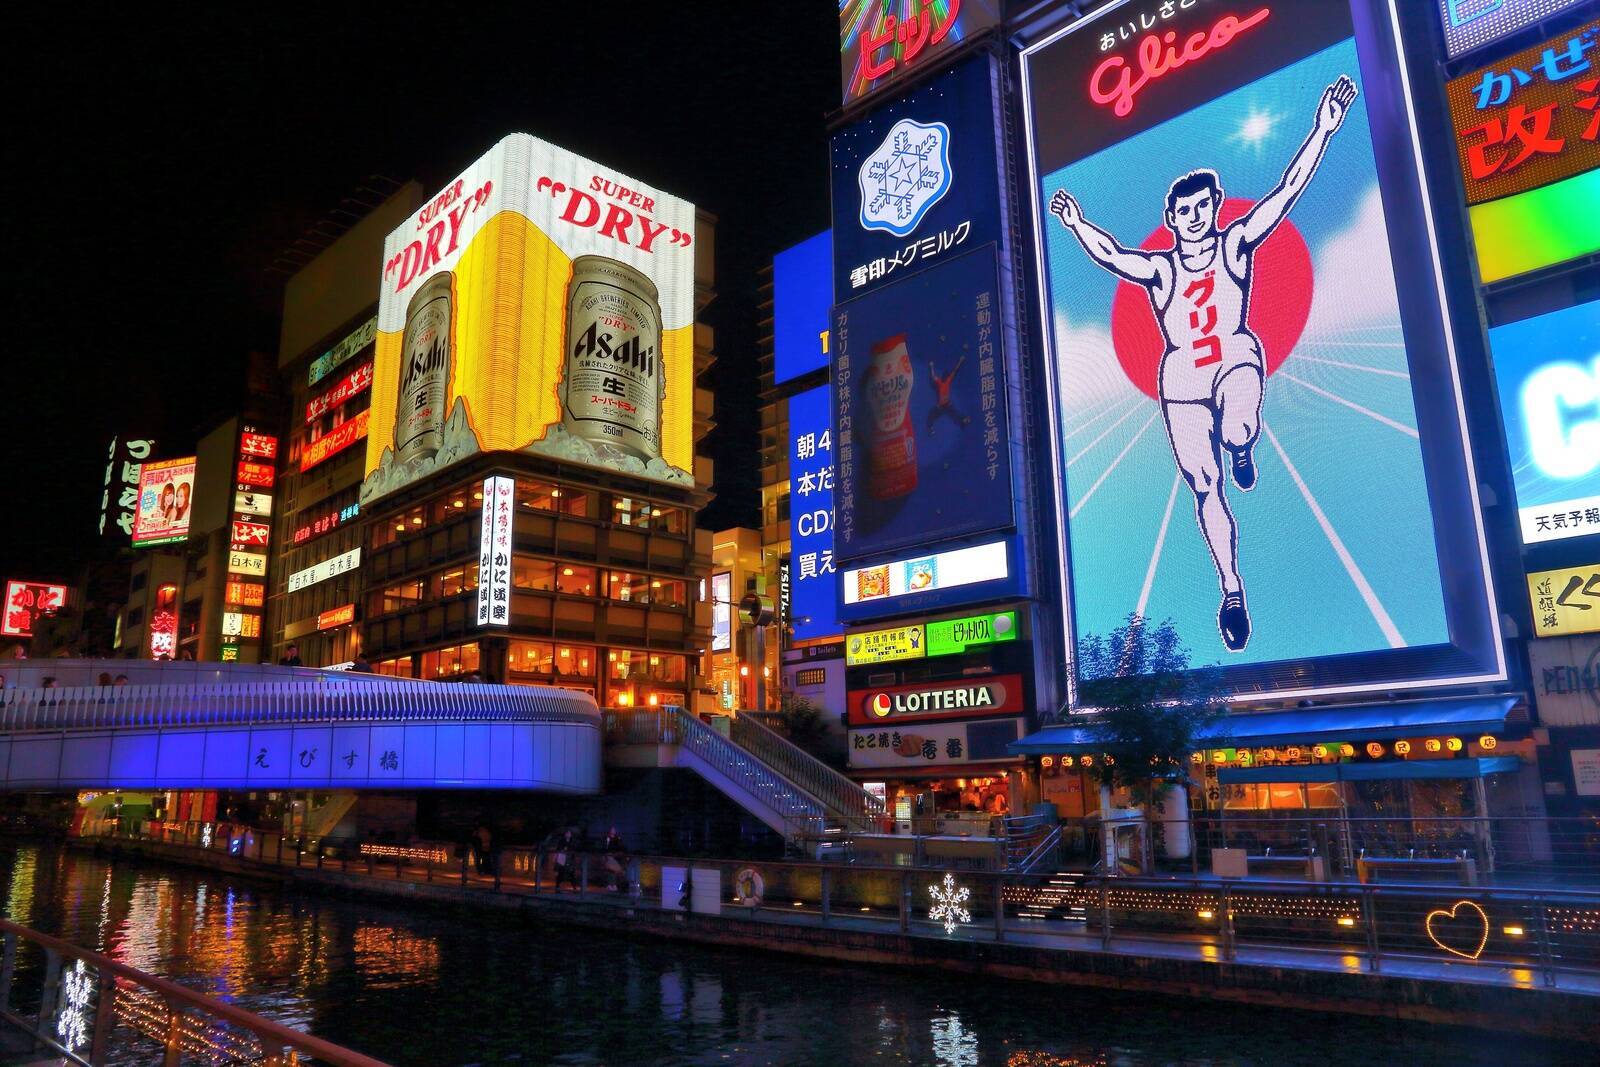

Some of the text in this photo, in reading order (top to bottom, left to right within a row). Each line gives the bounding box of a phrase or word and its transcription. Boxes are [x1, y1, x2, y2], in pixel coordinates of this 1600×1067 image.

[1471, 26, 1600, 110] かぜ
[416, 178, 464, 232] SUPER
[590, 175, 655, 213] SUPER
[850, 220, 971, 289] 雪印メグミルク
[1182, 269, 1223, 369] グリコ
[574, 321, 654, 378] Asahi
[402, 335, 447, 395] Asahi
[414, 389, 428, 411] 生
[602, 377, 626, 398] 生
[975, 292, 1000, 481] 運動が内臓脂肪を減らす
[591, 395, 637, 415] スーパードライ
[603, 424, 624, 438] 350ml
[1535, 507, 1600, 533] 天気予報
[231, 555, 263, 570] 白木屋
[329, 554, 352, 577] 白木屋
[492, 499, 509, 620] 本場の味 かに道楽
[479, 552, 490, 620] かに道楽
[1536, 577, 1559, 629] 道頓堀
[223, 636, 237, 644] 1F
[953, 619, 991, 643] ピタットハウス
[895, 686, 993, 713] LOTTERIA
[854, 731, 903, 750] たこ焼き
[254, 747, 400, 771] えびす橋
